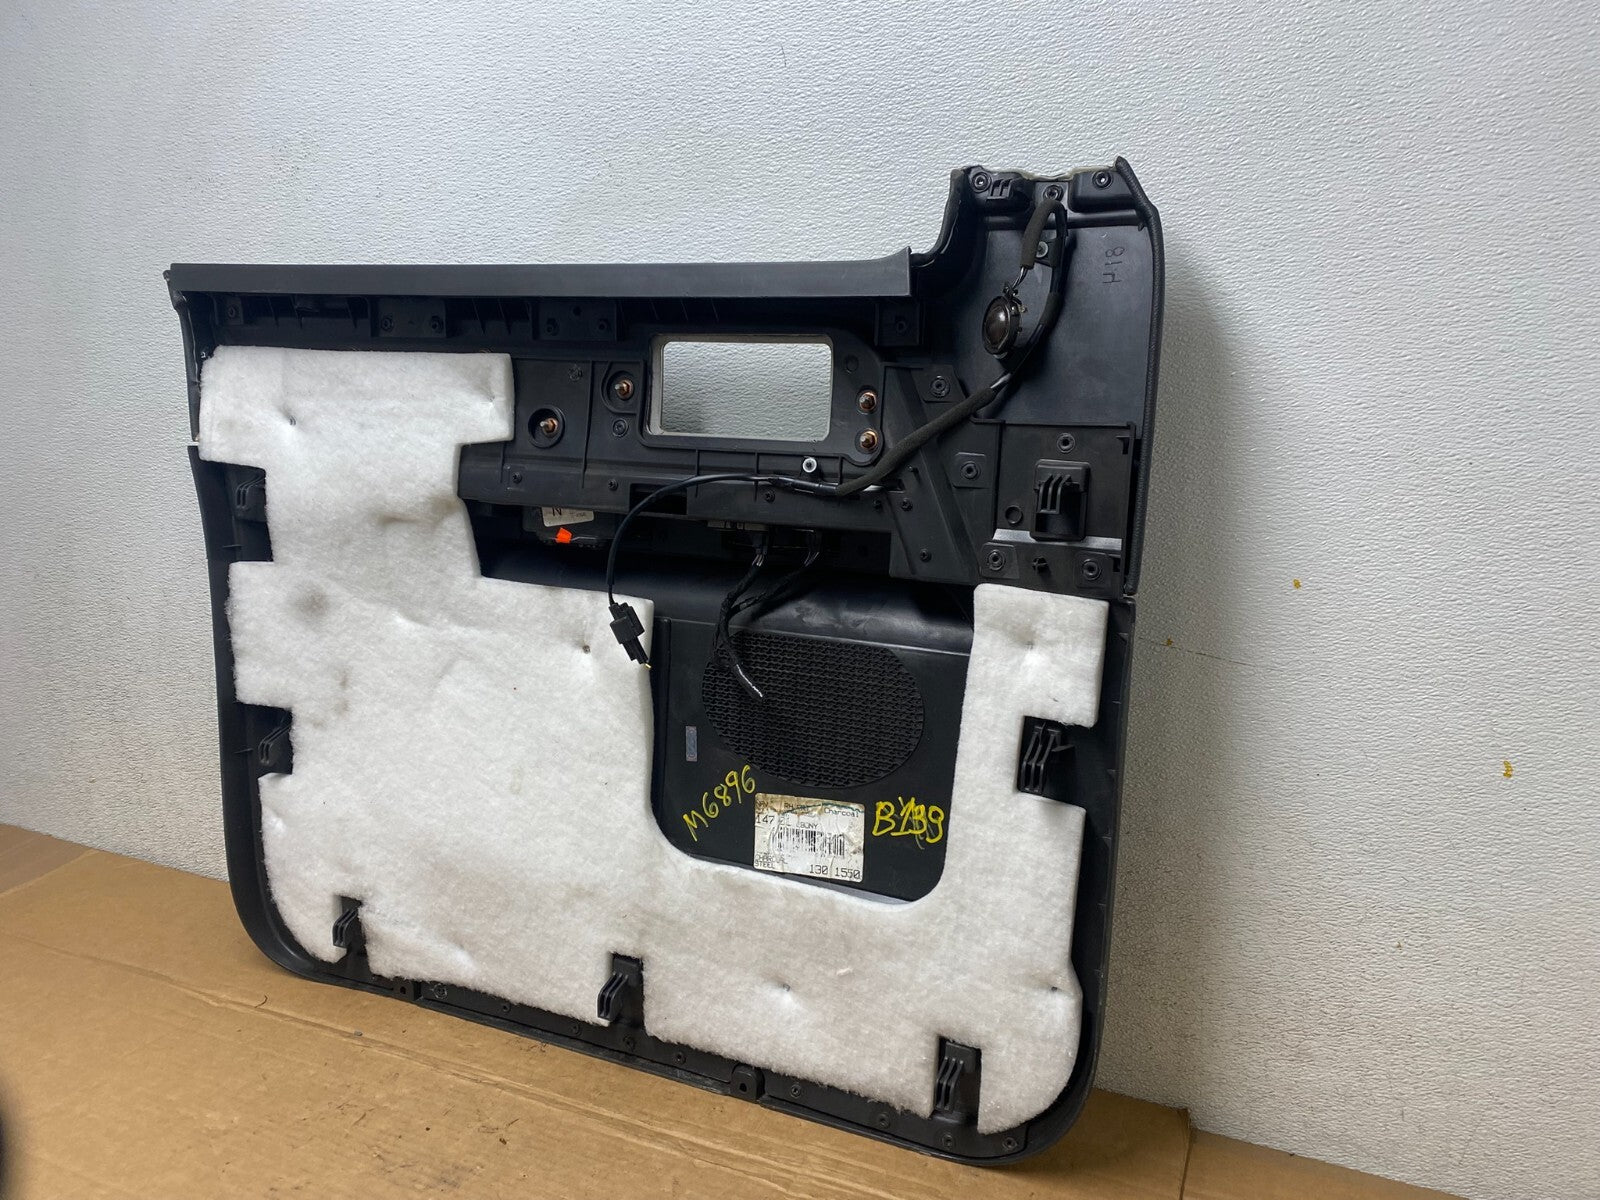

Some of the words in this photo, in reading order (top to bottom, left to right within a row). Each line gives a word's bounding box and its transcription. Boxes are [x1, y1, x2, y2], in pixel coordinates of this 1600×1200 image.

[682, 764, 756, 842] M6896
[756, 813, 775, 825] 147
[796, 821, 819, 830] BONY
[824, 807, 859, 819] Charcoal
[809, 863, 829, 876] 130
[834, 867, 862, 880] 1550
